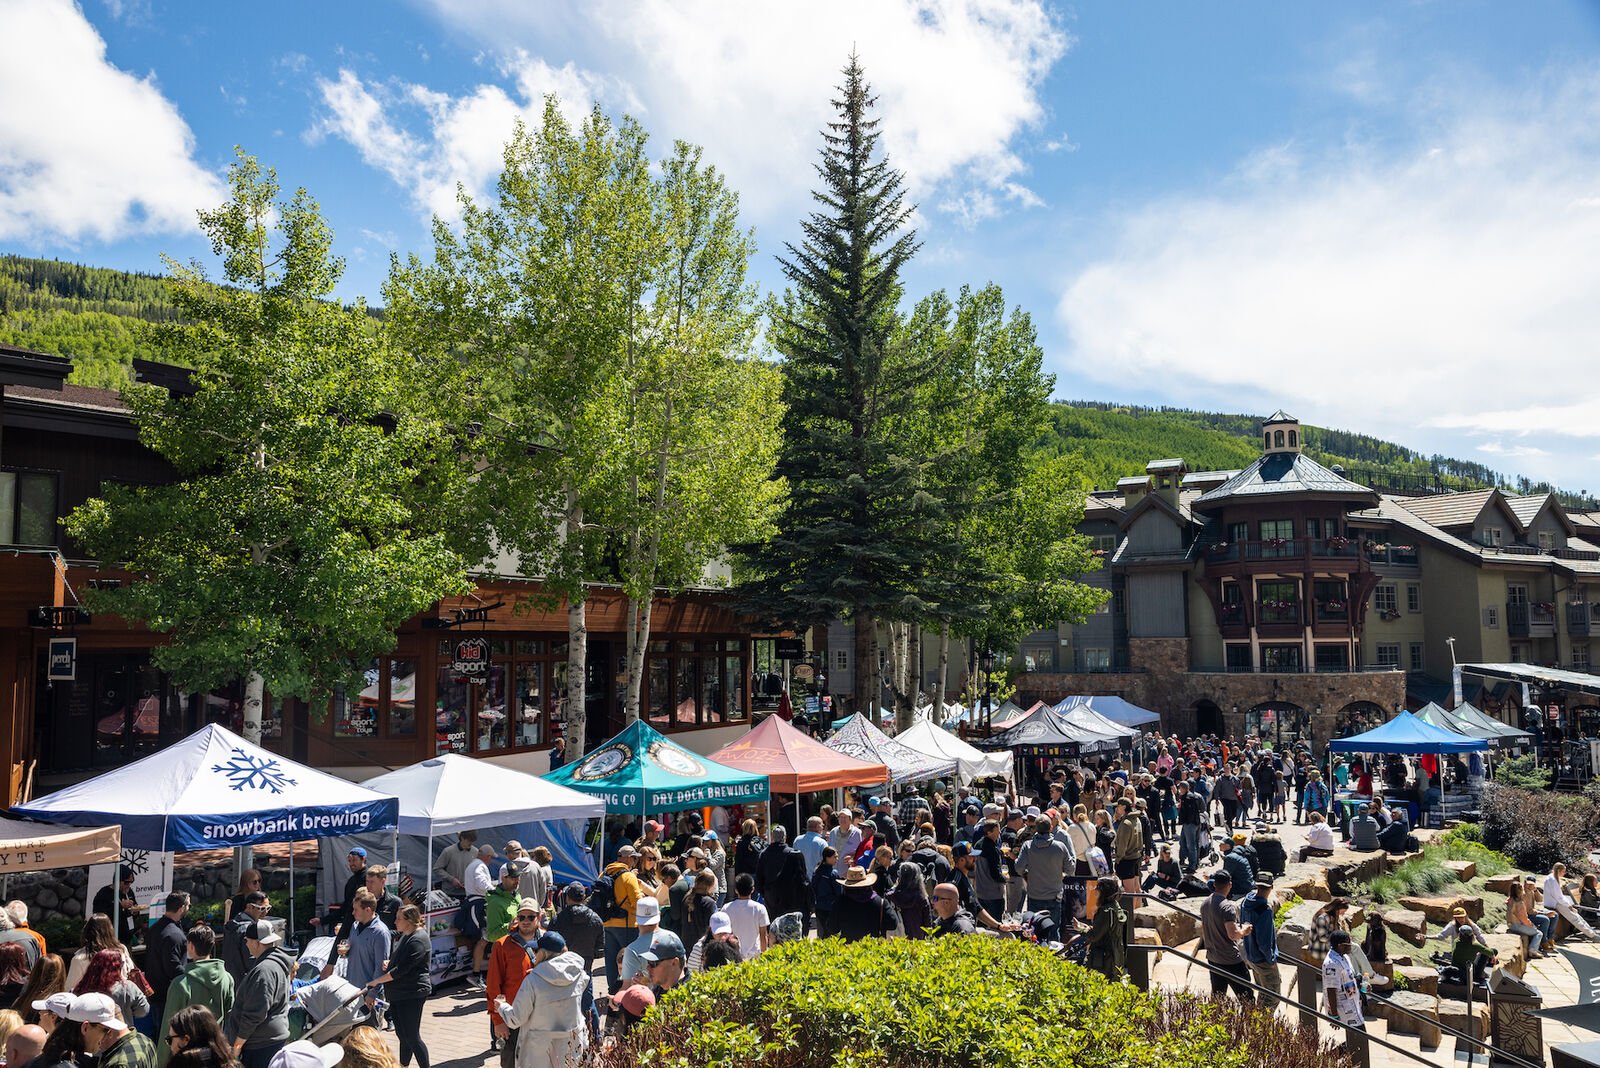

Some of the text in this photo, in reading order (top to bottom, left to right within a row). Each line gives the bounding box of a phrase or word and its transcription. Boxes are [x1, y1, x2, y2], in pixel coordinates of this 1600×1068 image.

[461, 645, 480, 659] kid
[454, 660, 487, 673] sport
[652, 792, 674, 806] DRY
[677, 788, 704, 803] DOCK
[707, 784, 750, 799] BREWING
[203, 810, 370, 839] snowbank brewing
[0, 850, 45, 866] YTE
